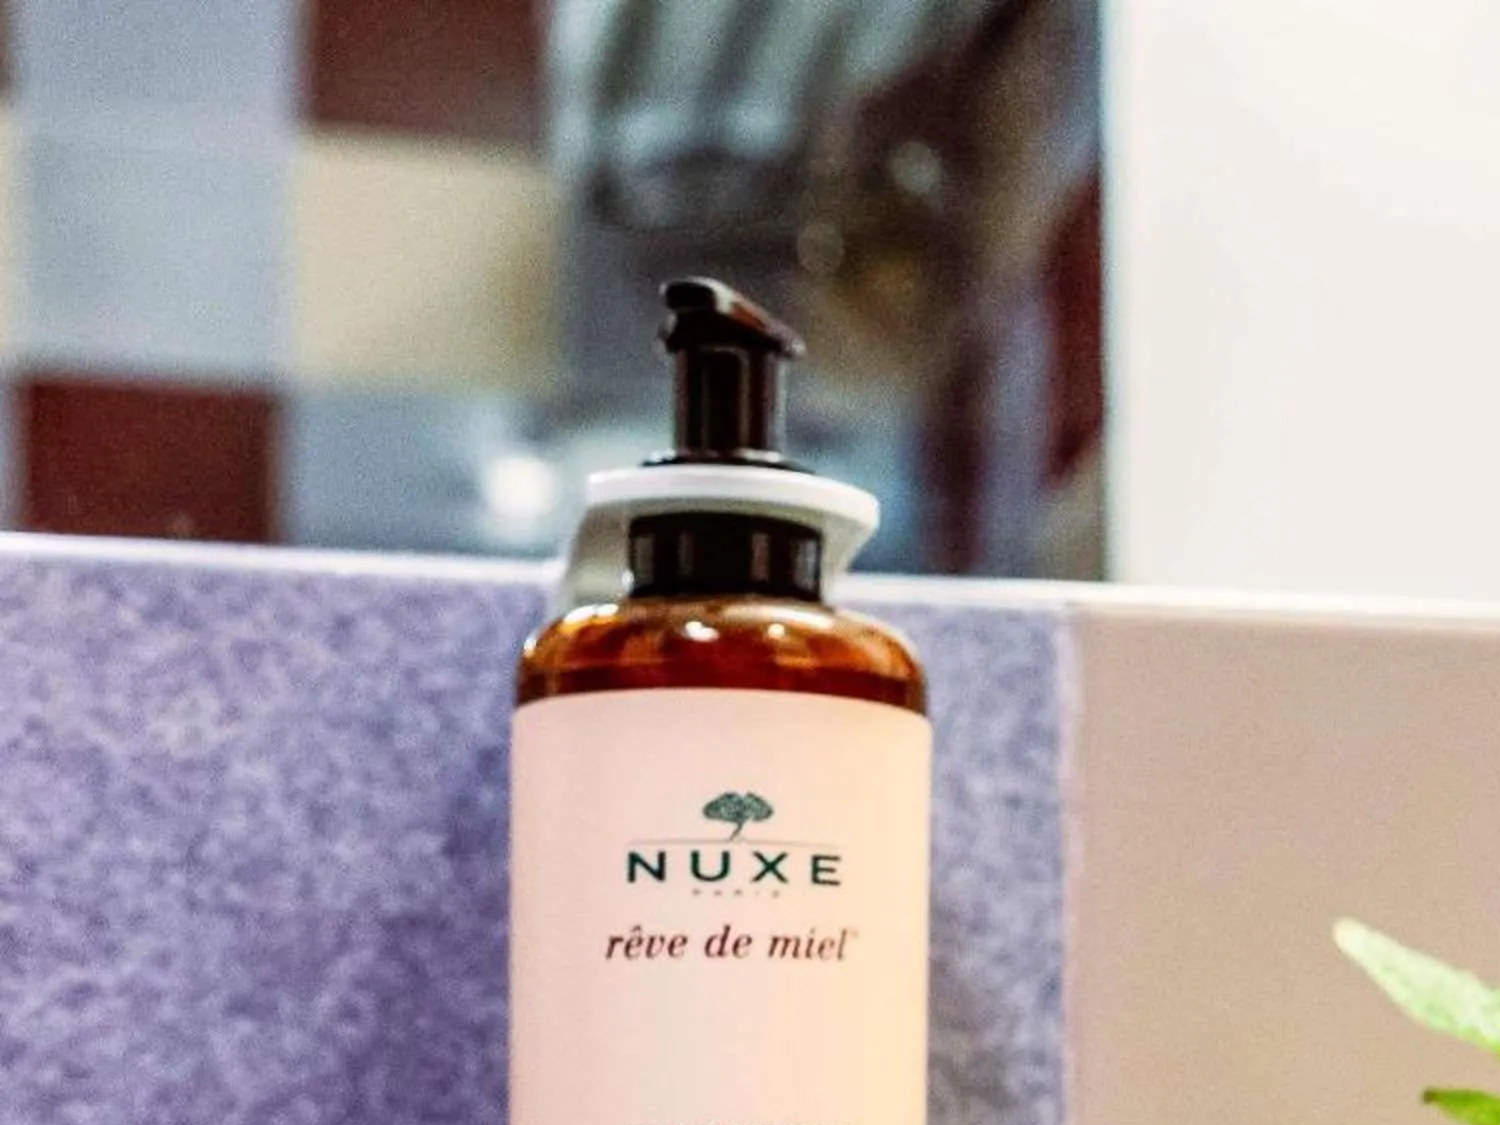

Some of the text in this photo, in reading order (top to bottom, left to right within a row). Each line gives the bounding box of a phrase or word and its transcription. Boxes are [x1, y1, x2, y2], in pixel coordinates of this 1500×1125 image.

[627, 850, 841, 886] NUXE
[605, 925, 688, 960] rêve
[704, 924, 752, 959] de
